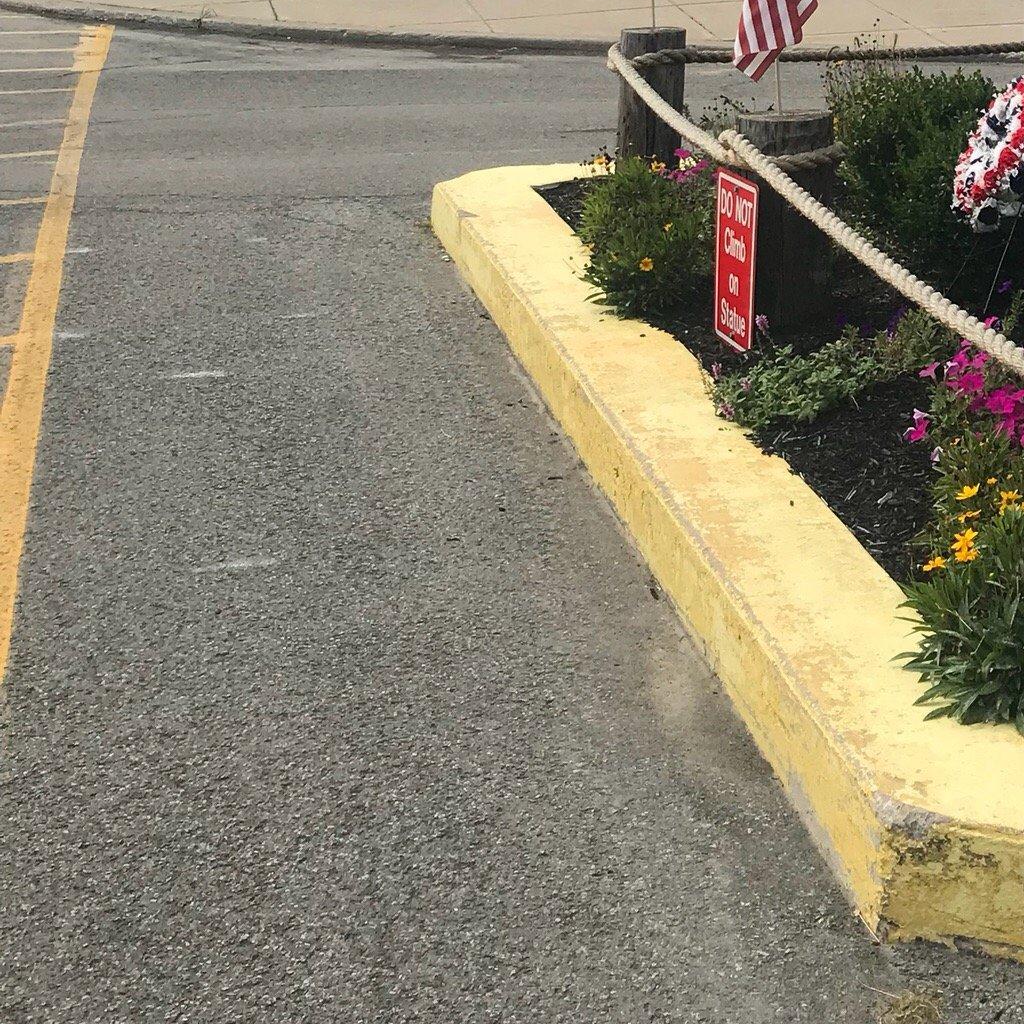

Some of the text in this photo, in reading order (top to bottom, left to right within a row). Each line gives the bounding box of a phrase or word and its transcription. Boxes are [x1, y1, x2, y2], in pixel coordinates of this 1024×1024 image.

[721, 187, 753, 229] DO NOT
[724, 226, 746, 263] Climb
[728, 273, 739, 297] on
[721, 297, 746, 338] Statue
